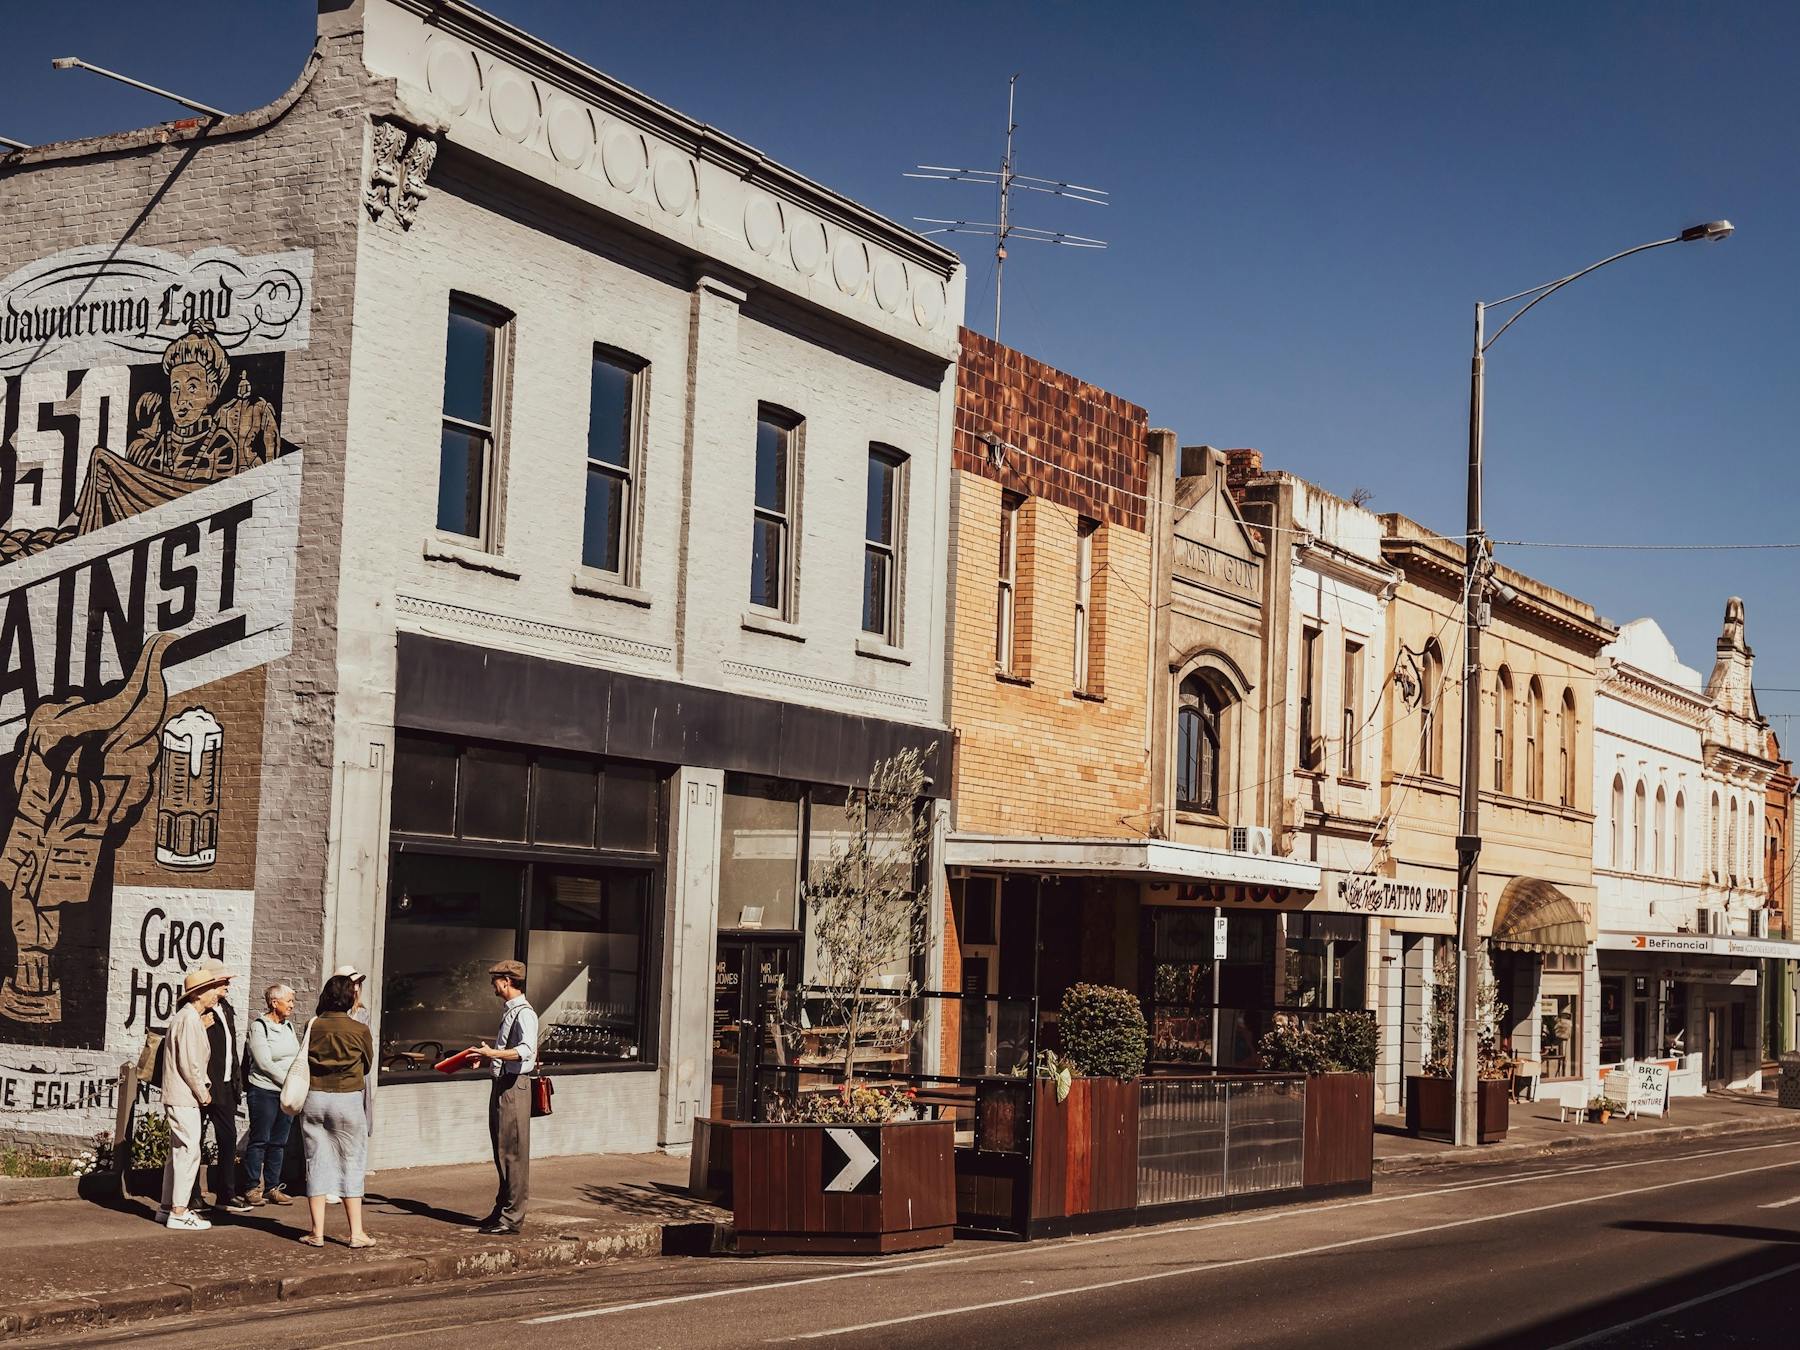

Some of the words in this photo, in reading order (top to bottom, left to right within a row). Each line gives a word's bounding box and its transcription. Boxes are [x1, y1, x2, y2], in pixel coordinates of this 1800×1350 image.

[0, 296, 150, 345] dawurrung
[156, 275, 234, 329] Land
[1383, 883, 1422, 911] TATTOO
[1425, 887, 1449, 914] SHOP
[1649, 939, 1709, 950] BeFinancial
[760, 962, 772, 974] MR
[715, 973, 739, 985] JONES
[1638, 1066, 1663, 1076] BRIC
[32, 1077, 150, 1110] EGLINTN
